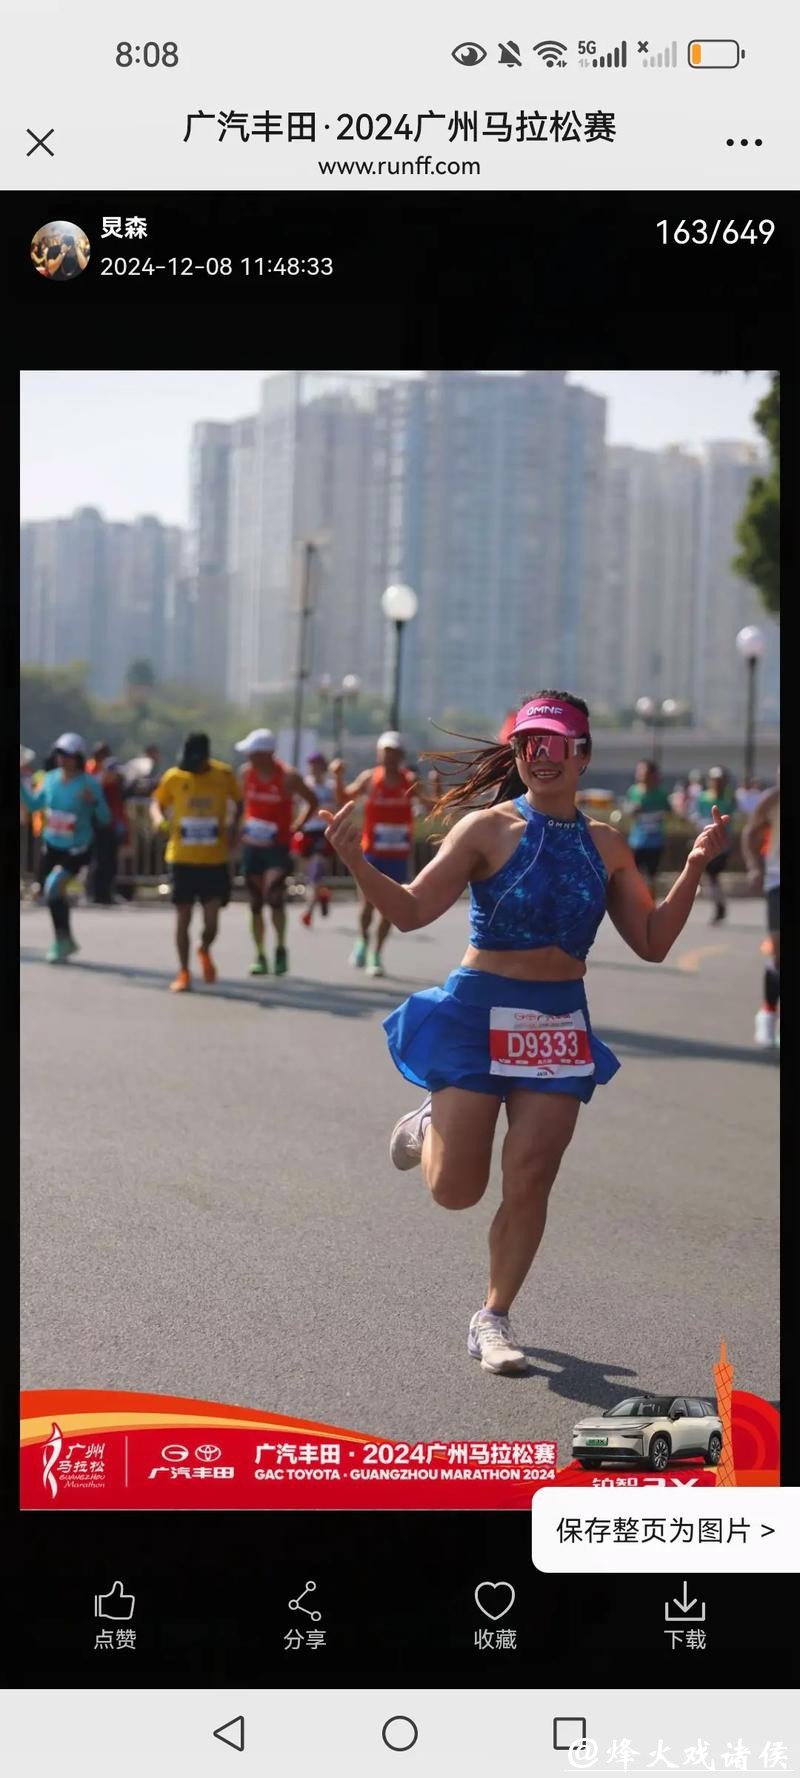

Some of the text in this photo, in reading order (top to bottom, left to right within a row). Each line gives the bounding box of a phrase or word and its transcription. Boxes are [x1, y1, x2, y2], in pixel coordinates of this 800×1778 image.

[115, 41, 179, 68] 8:08
[577, 41, 597, 55] 5G
[183, 109, 617, 143] 广汽丰田·2024广州马拉松赛
[317, 156, 481, 175] www.runff.com
[100, 215, 148, 240] 炅森
[656, 218, 776, 245] 163/649
[100, 257, 334, 276] 2024-12-08 11:48:33
[507, 1031, 578, 1058] D9333
[556, 1516, 751, 1544] 保存整页为图片
[93, 1628, 137, 1650] 点赞
[283, 1628, 327, 1650] 分享
[474, 1628, 517, 1650] 收藏
[663, 1628, 707, 1650] 下载
